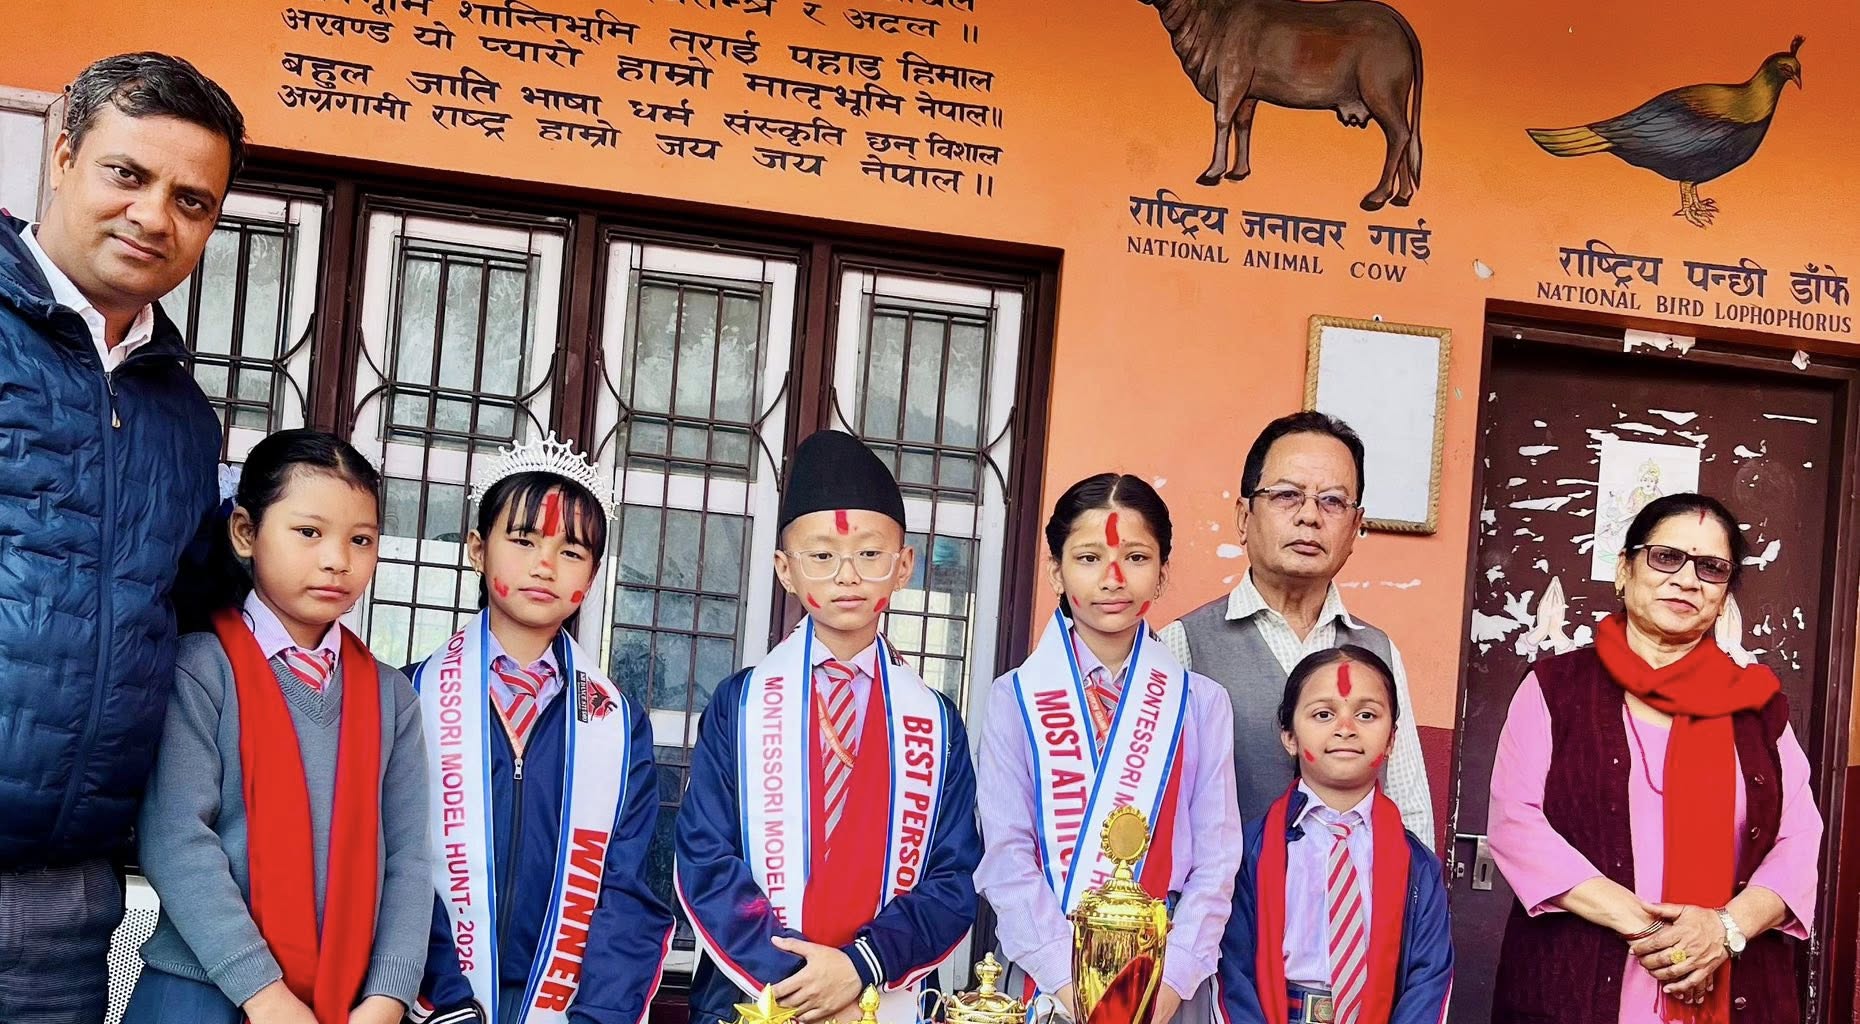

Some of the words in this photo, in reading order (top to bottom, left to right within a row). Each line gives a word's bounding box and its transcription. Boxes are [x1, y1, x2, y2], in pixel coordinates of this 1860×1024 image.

[282, 7, 394, 43] अखण्ड
[413, 20, 456, 50] यो
[478, 36, 584, 68] प्यारो
[617, 55, 714, 90] हाम्रो
[742, 72, 906, 118] मातृभूमि
[669, 29, 761, 66] तराई
[788, 45, 884, 81] पहाड
[897, 51, 994, 92] हिमाल
[843, 9, 941, 38] अटल
[277, 84, 412, 122] अग्रगामी
[432, 104, 512, 142] राष्ट्र
[536, 117, 622, 149] हाम्रो
[655, 133, 722, 161] जय
[753, 147, 828, 177] जय
[860, 154, 965, 194] नेपाल
[282, 52, 374, 90] बहुल
[406, 66, 502, 103] जाति
[521, 86, 603, 117] भाषा
[628, 98, 695, 128] धर्म
[723, 109, 847, 147] संस्कृति
[865, 131, 920, 161] छन्
[925, 131, 1003, 166] विशाल
[1127, 236, 1229, 264] NATIONAL
[1243, 250, 1323, 275] ANIMAL
[1350, 261, 1408, 283] COW
[1130, 188, 1228, 240] राष्ट्रिय
[1240, 211, 1347, 250] जनावर
[1368, 218, 1431, 264] गाई
[1537, 282, 1641, 310] NATIONAL
[1656, 296, 1704, 317] BIRD
[1715, 303, 1852, 334] LOPHOPHORUS
[1559, 239, 1663, 289] राष्ट्रिय
[1683, 257, 1768, 298] पन्छी
[762, 676, 784, 815] MONTESSORI
[903, 715, 934, 786] BEST
[1034, 689, 1082, 761] MOST
[1120, 668, 1168, 790] MONTESSORI
[441, 753, 465, 837] MODEL
[764, 816, 784, 899] MODEL
[534, 828, 608, 1013] WINNER
